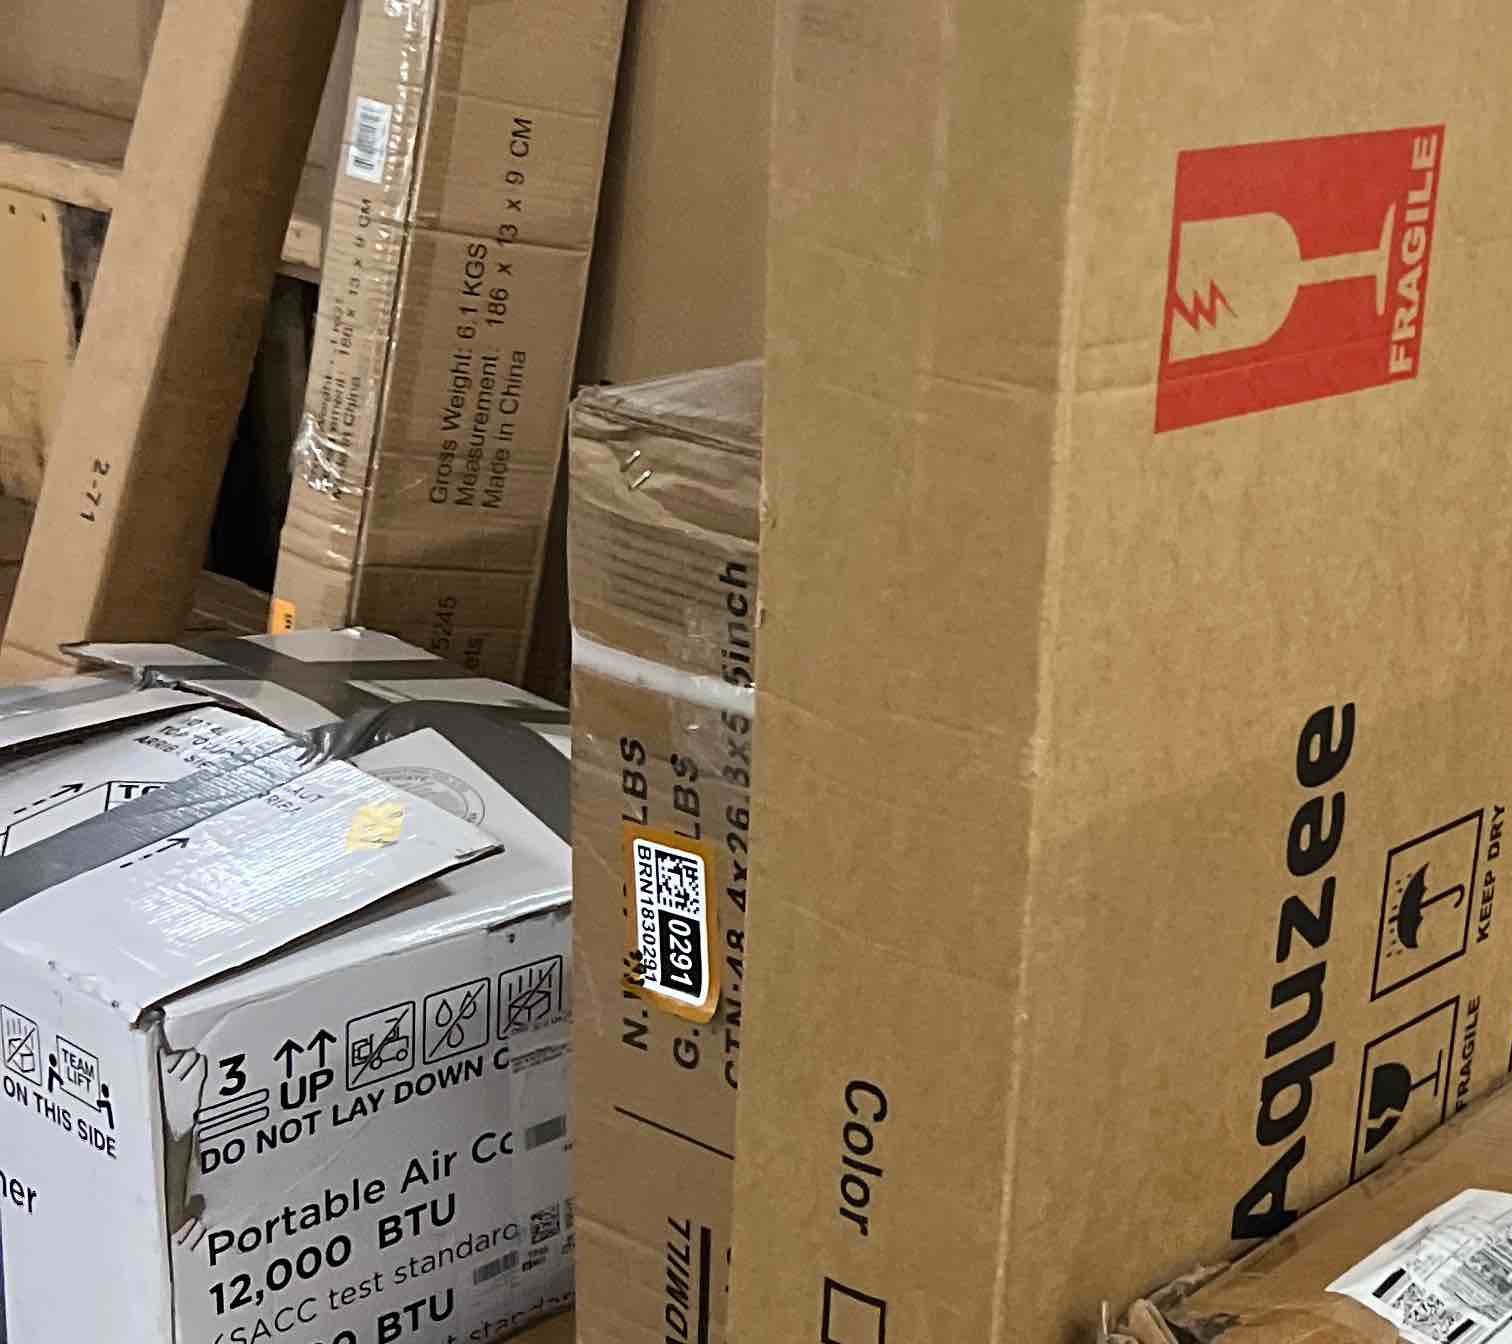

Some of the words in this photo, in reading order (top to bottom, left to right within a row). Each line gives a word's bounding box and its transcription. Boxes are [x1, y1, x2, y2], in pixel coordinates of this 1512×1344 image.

[506, 170, 526, 187] 9
[510, 116, 535, 159] CM
[463, 242, 489, 298] KGS
[498, 223, 520, 248] 13
[1389, 132, 1438, 375] FRAGILE
[485, 287, 510, 328] 186
[440, 347, 473, 433] Weight:
[453, 347, 500, 507] Measurement:
[482, 443, 511, 509] Made
[499, 350, 528, 416] China
[429, 439, 458, 506] Gross
[620, 736, 649, 826] LBS
[671, 753, 701, 841] LBS
[636, 842, 659, 984] BRN1830291
[1475, 870, 1496, 945] KEEP
[1486, 804, 1505, 866] DRY
[667, 919, 693, 988] 0291
[1231, 701, 1356, 1240] Aquzee
[61, 1047, 96, 1081] TEAM
[66, 1066, 93, 1094] LIFT
[218, 1053, 247, 1097] 3
[279, 1068, 334, 1110] UP
[1455, 995, 1481, 1113] FRAGILE
[3, 1075, 29, 1107] ON
[32, 1090, 73, 1133] THIS
[77, 1117, 118, 1160] SIDE
[200, 1138, 246, 1175] DO
[256, 1110, 323, 1154] NOT
[332, 1088, 385, 1127] LAY
[394, 1056, 484, 1106] DOWN
[839, 1079, 889, 1236] Color
[207, 1178, 386, 1266] Portable
[399, 1148, 458, 1194] Air
[208, 1234, 352, 1316] 12,000
[376, 1193, 456, 1250] BTU
[327, 1270, 385, 1311] test
